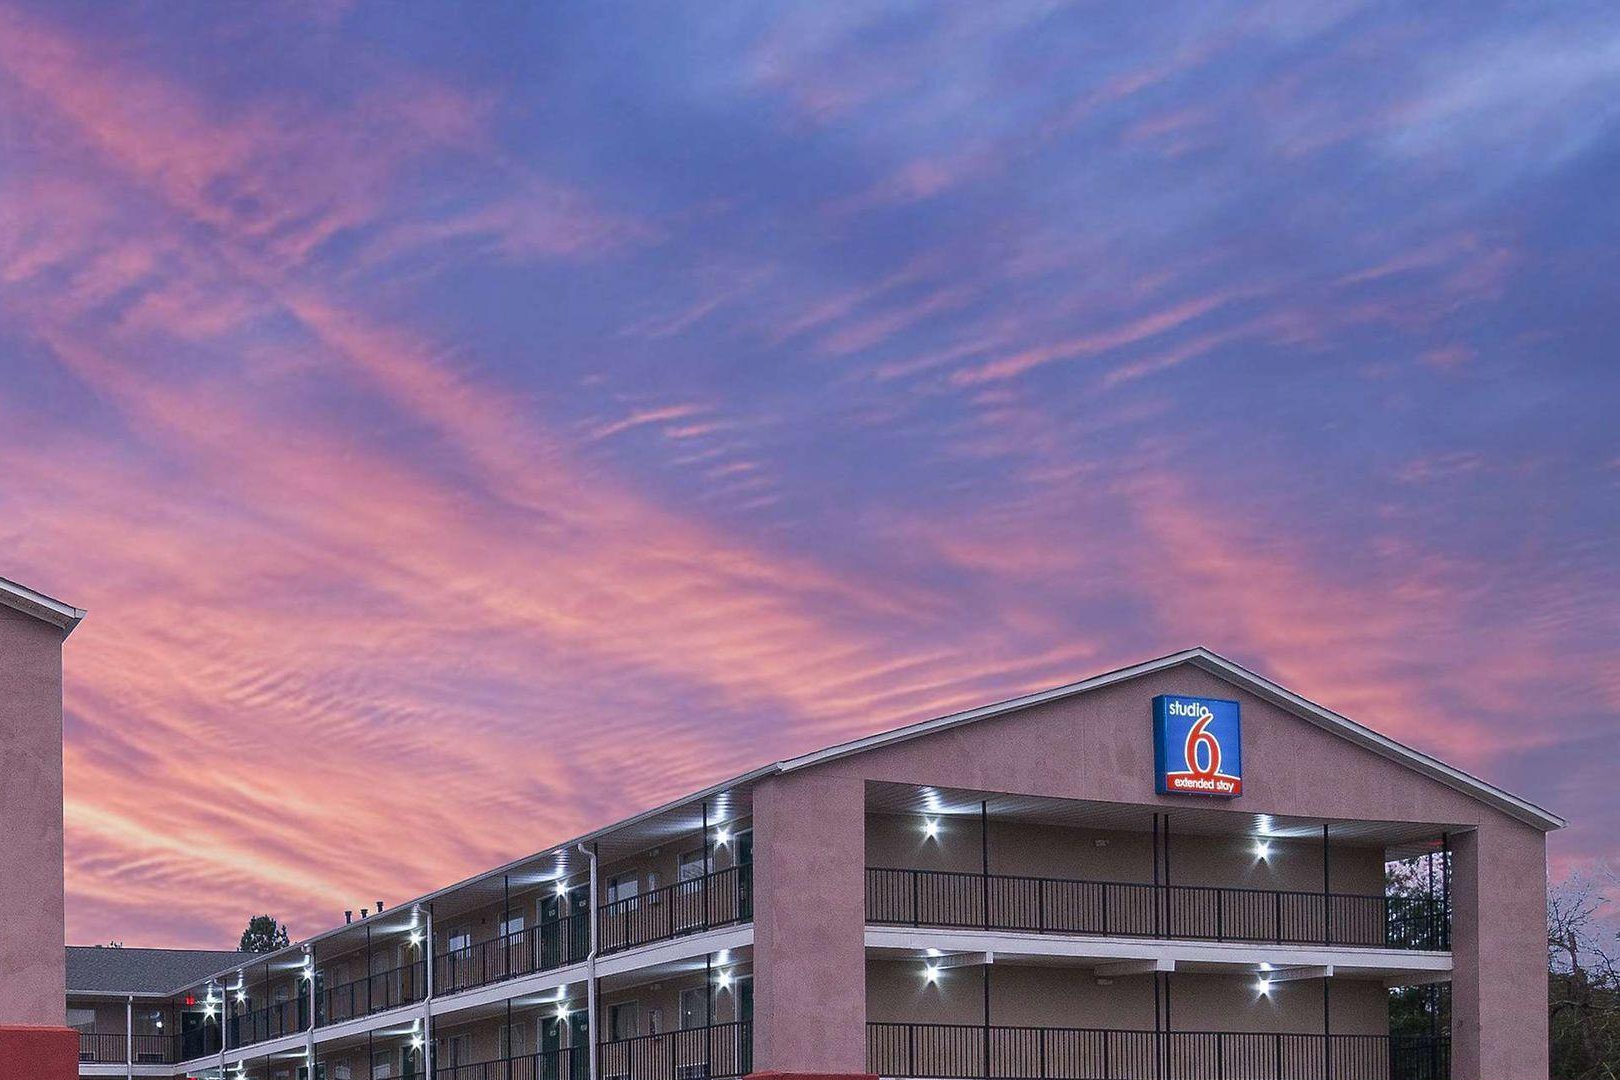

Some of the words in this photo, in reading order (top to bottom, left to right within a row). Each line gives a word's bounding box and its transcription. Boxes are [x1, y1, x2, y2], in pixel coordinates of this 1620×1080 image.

[1169, 700, 1209, 717] studio
[1185, 713, 1221, 774] 6
[1174, 777, 1214, 790] extended
[1216, 779, 1235, 793] stay
